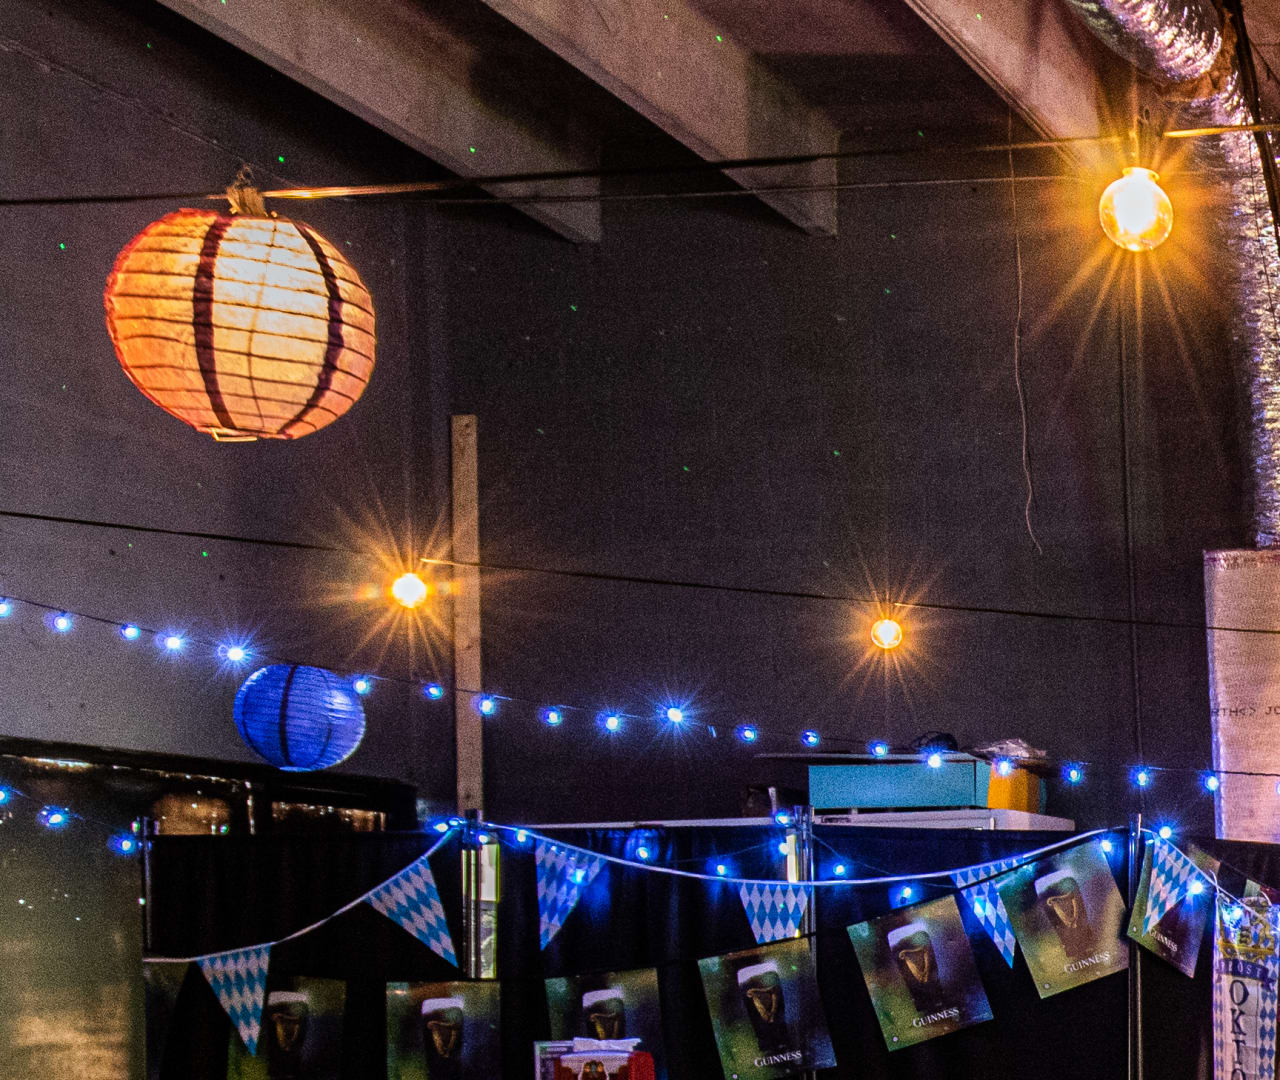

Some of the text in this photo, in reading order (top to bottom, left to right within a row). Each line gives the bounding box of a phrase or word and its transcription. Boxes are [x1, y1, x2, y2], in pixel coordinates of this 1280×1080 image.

[1150, 927, 1178, 952] GUINNESS
[1064, 951, 1110, 973] GUINNESS
[912, 1007, 960, 1028] GUINNESS
[754, 1050, 802, 1068] GUINNESS
